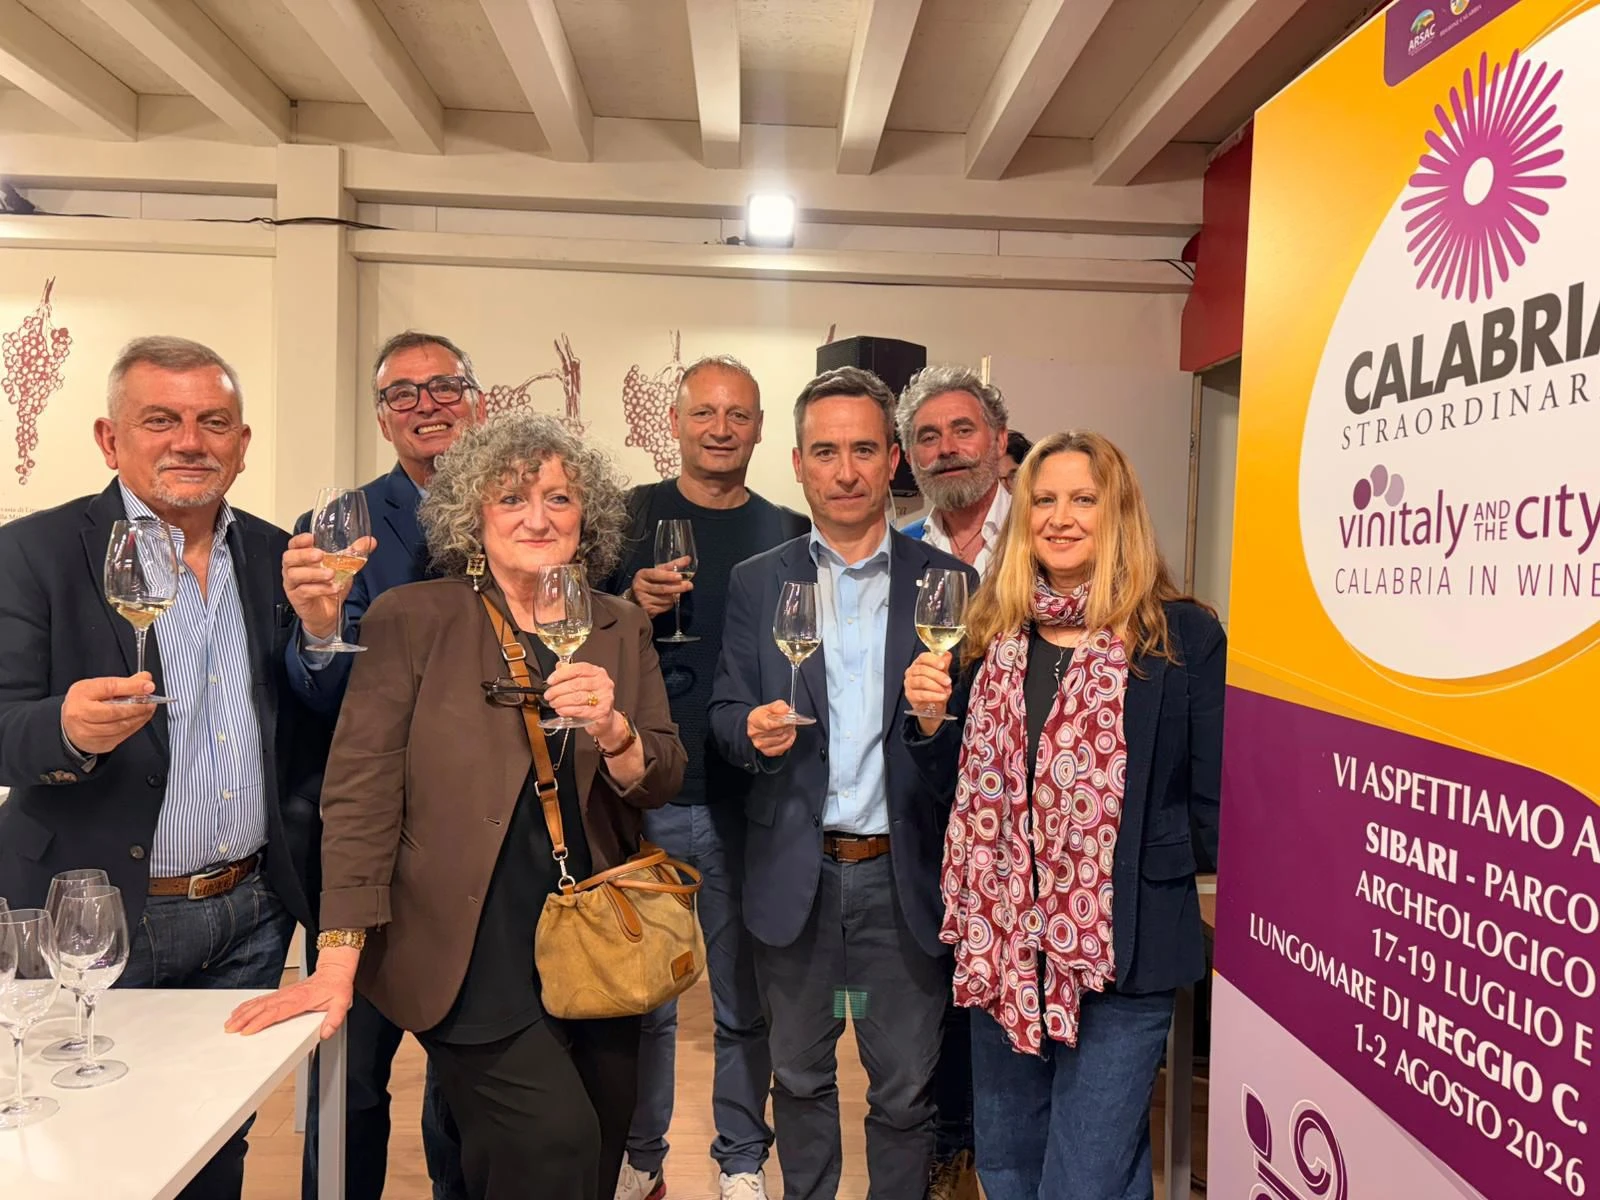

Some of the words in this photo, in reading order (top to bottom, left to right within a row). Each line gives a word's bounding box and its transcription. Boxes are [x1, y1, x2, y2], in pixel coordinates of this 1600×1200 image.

[1408, 23, 1436, 51] ARSAC
[1342, 372, 1600, 450] STRAORDINAR
[1338, 489, 1469, 560] vinitaly
[1473, 500, 1511, 521] AND
[1473, 520, 1508, 541] THE
[1515, 484, 1600, 555] city
[1335, 566, 1451, 595] CALABRIA
[1469, 565, 1497, 596] IN
[1517, 563, 1600, 597] WINE
[1333, 752, 1357, 791] VI
[1361, 761, 1564, 849] ASPETTIAMO
[1572, 815, 1600, 864] A
[1366, 821, 1458, 884] SIBARI
[1466, 874, 1476, 884] -
[1484, 862, 1599, 934] PARCO
[1355, 870, 1596, 998] ARCHEOLOGICO
[1250, 912, 1376, 1010] LUNGOMARE
[1383, 985, 1409, 1030] DI
[1417, 1004, 1543, 1103] REGGIO
[1552, 1083, 1588, 1135] C.
[1372, 928, 1436, 983] 17-19
[1444, 960, 1563, 1047] LUGLIO
[1574, 1021, 1593, 1066] E
[1354, 1023, 1387, 1068] 1-2
[1394, 1049, 1502, 1140] AGOSTO
[1506, 1118, 1585, 1197] 2026
